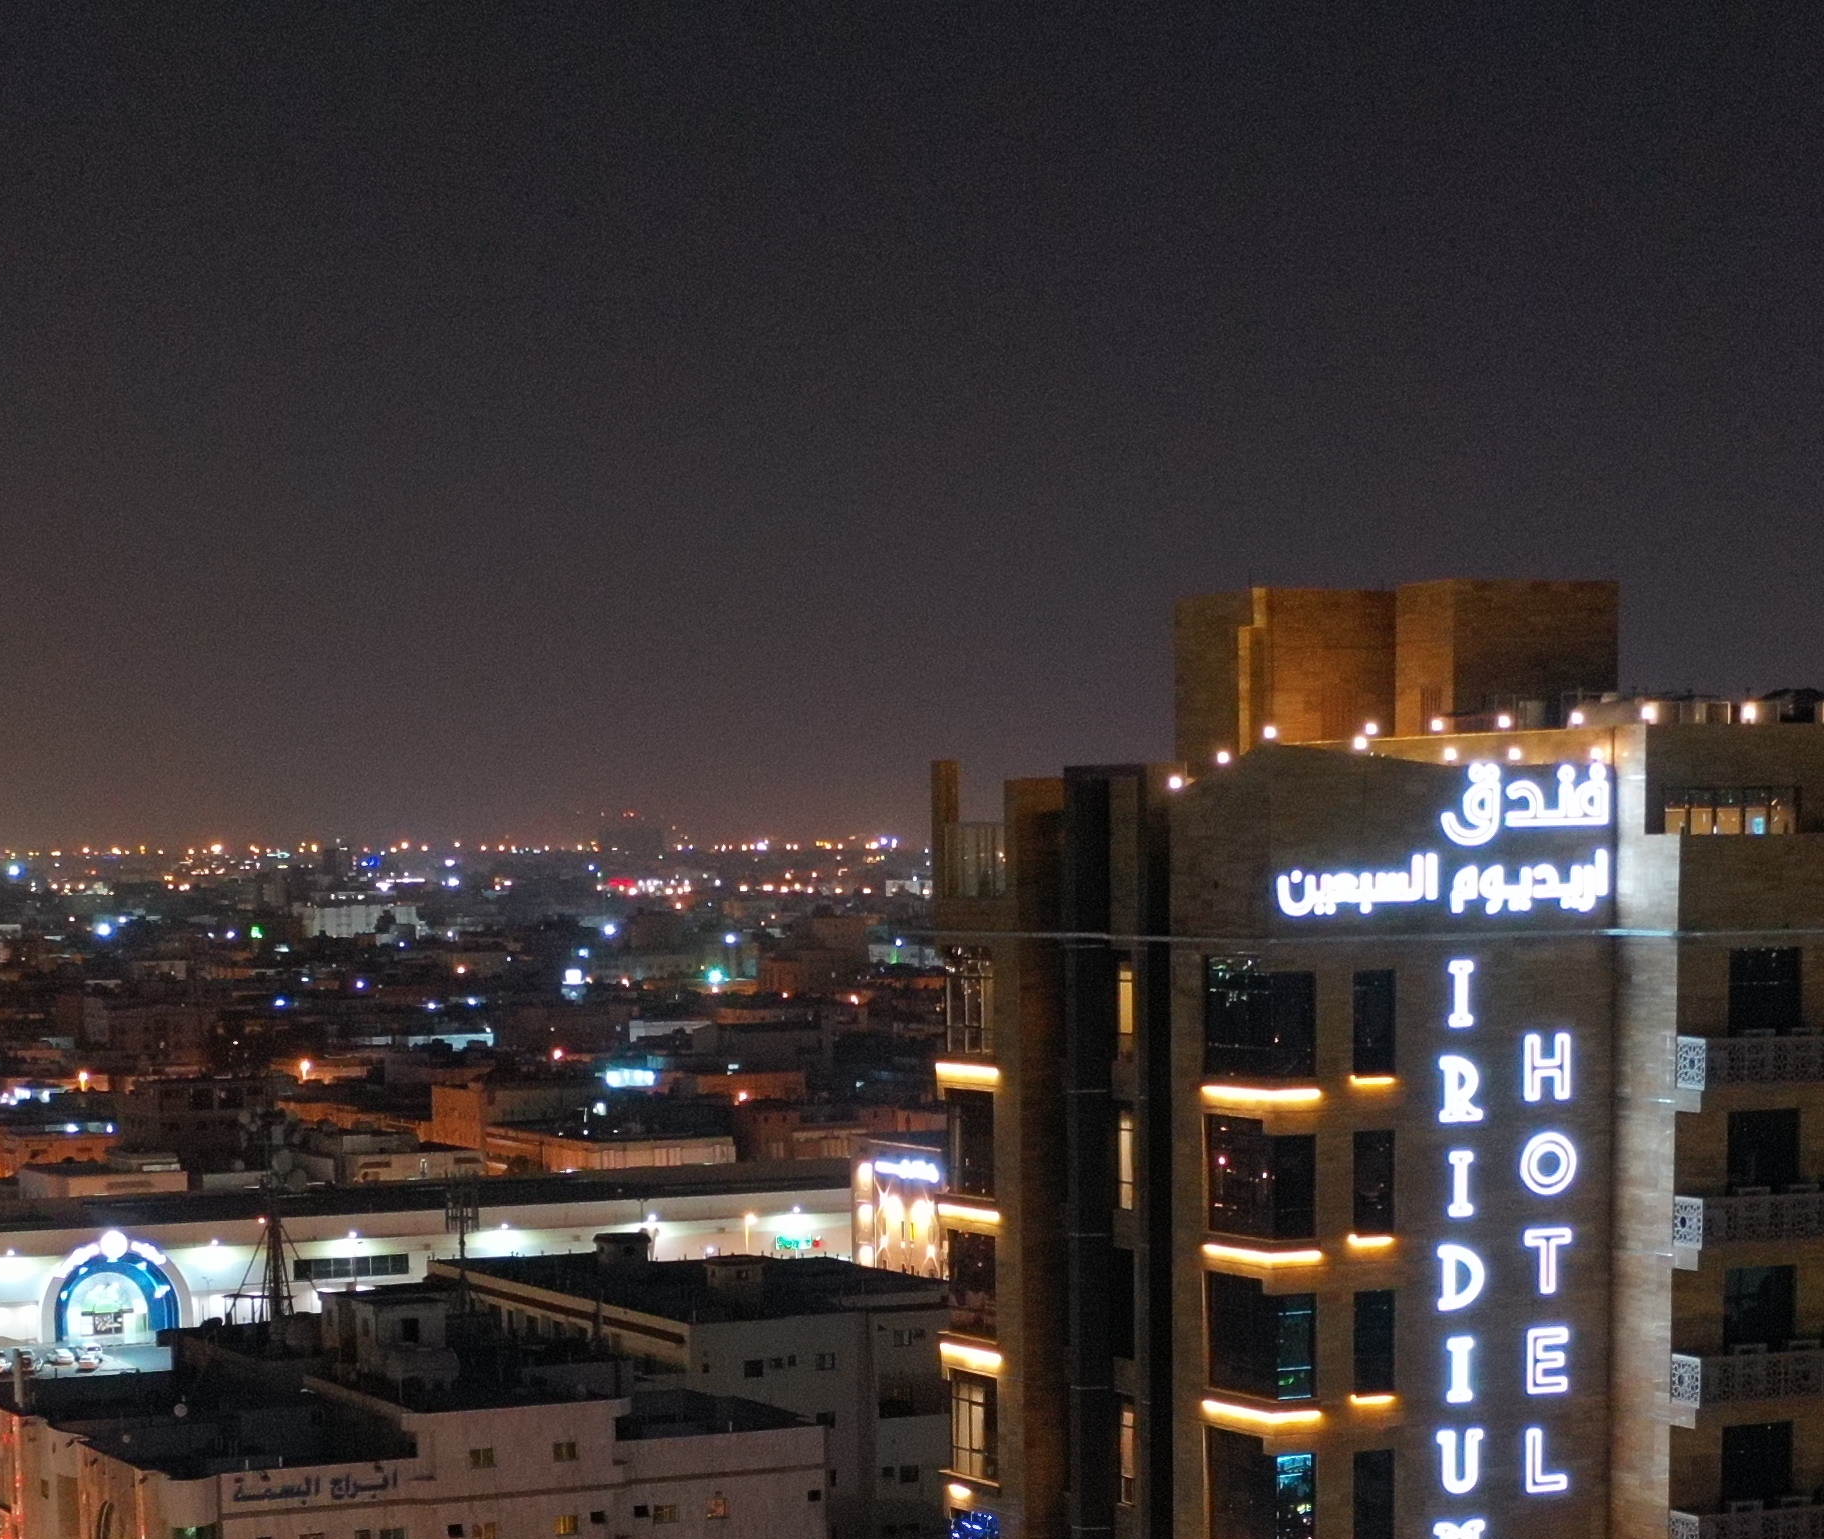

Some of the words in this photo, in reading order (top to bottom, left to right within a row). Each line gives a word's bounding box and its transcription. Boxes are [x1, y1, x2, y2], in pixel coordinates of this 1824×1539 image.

[1440, 762, 1610, 846] فندق
[1276, 851, 1440, 917] السبعين
[1519, 1031, 1578, 1494] HOTEL
